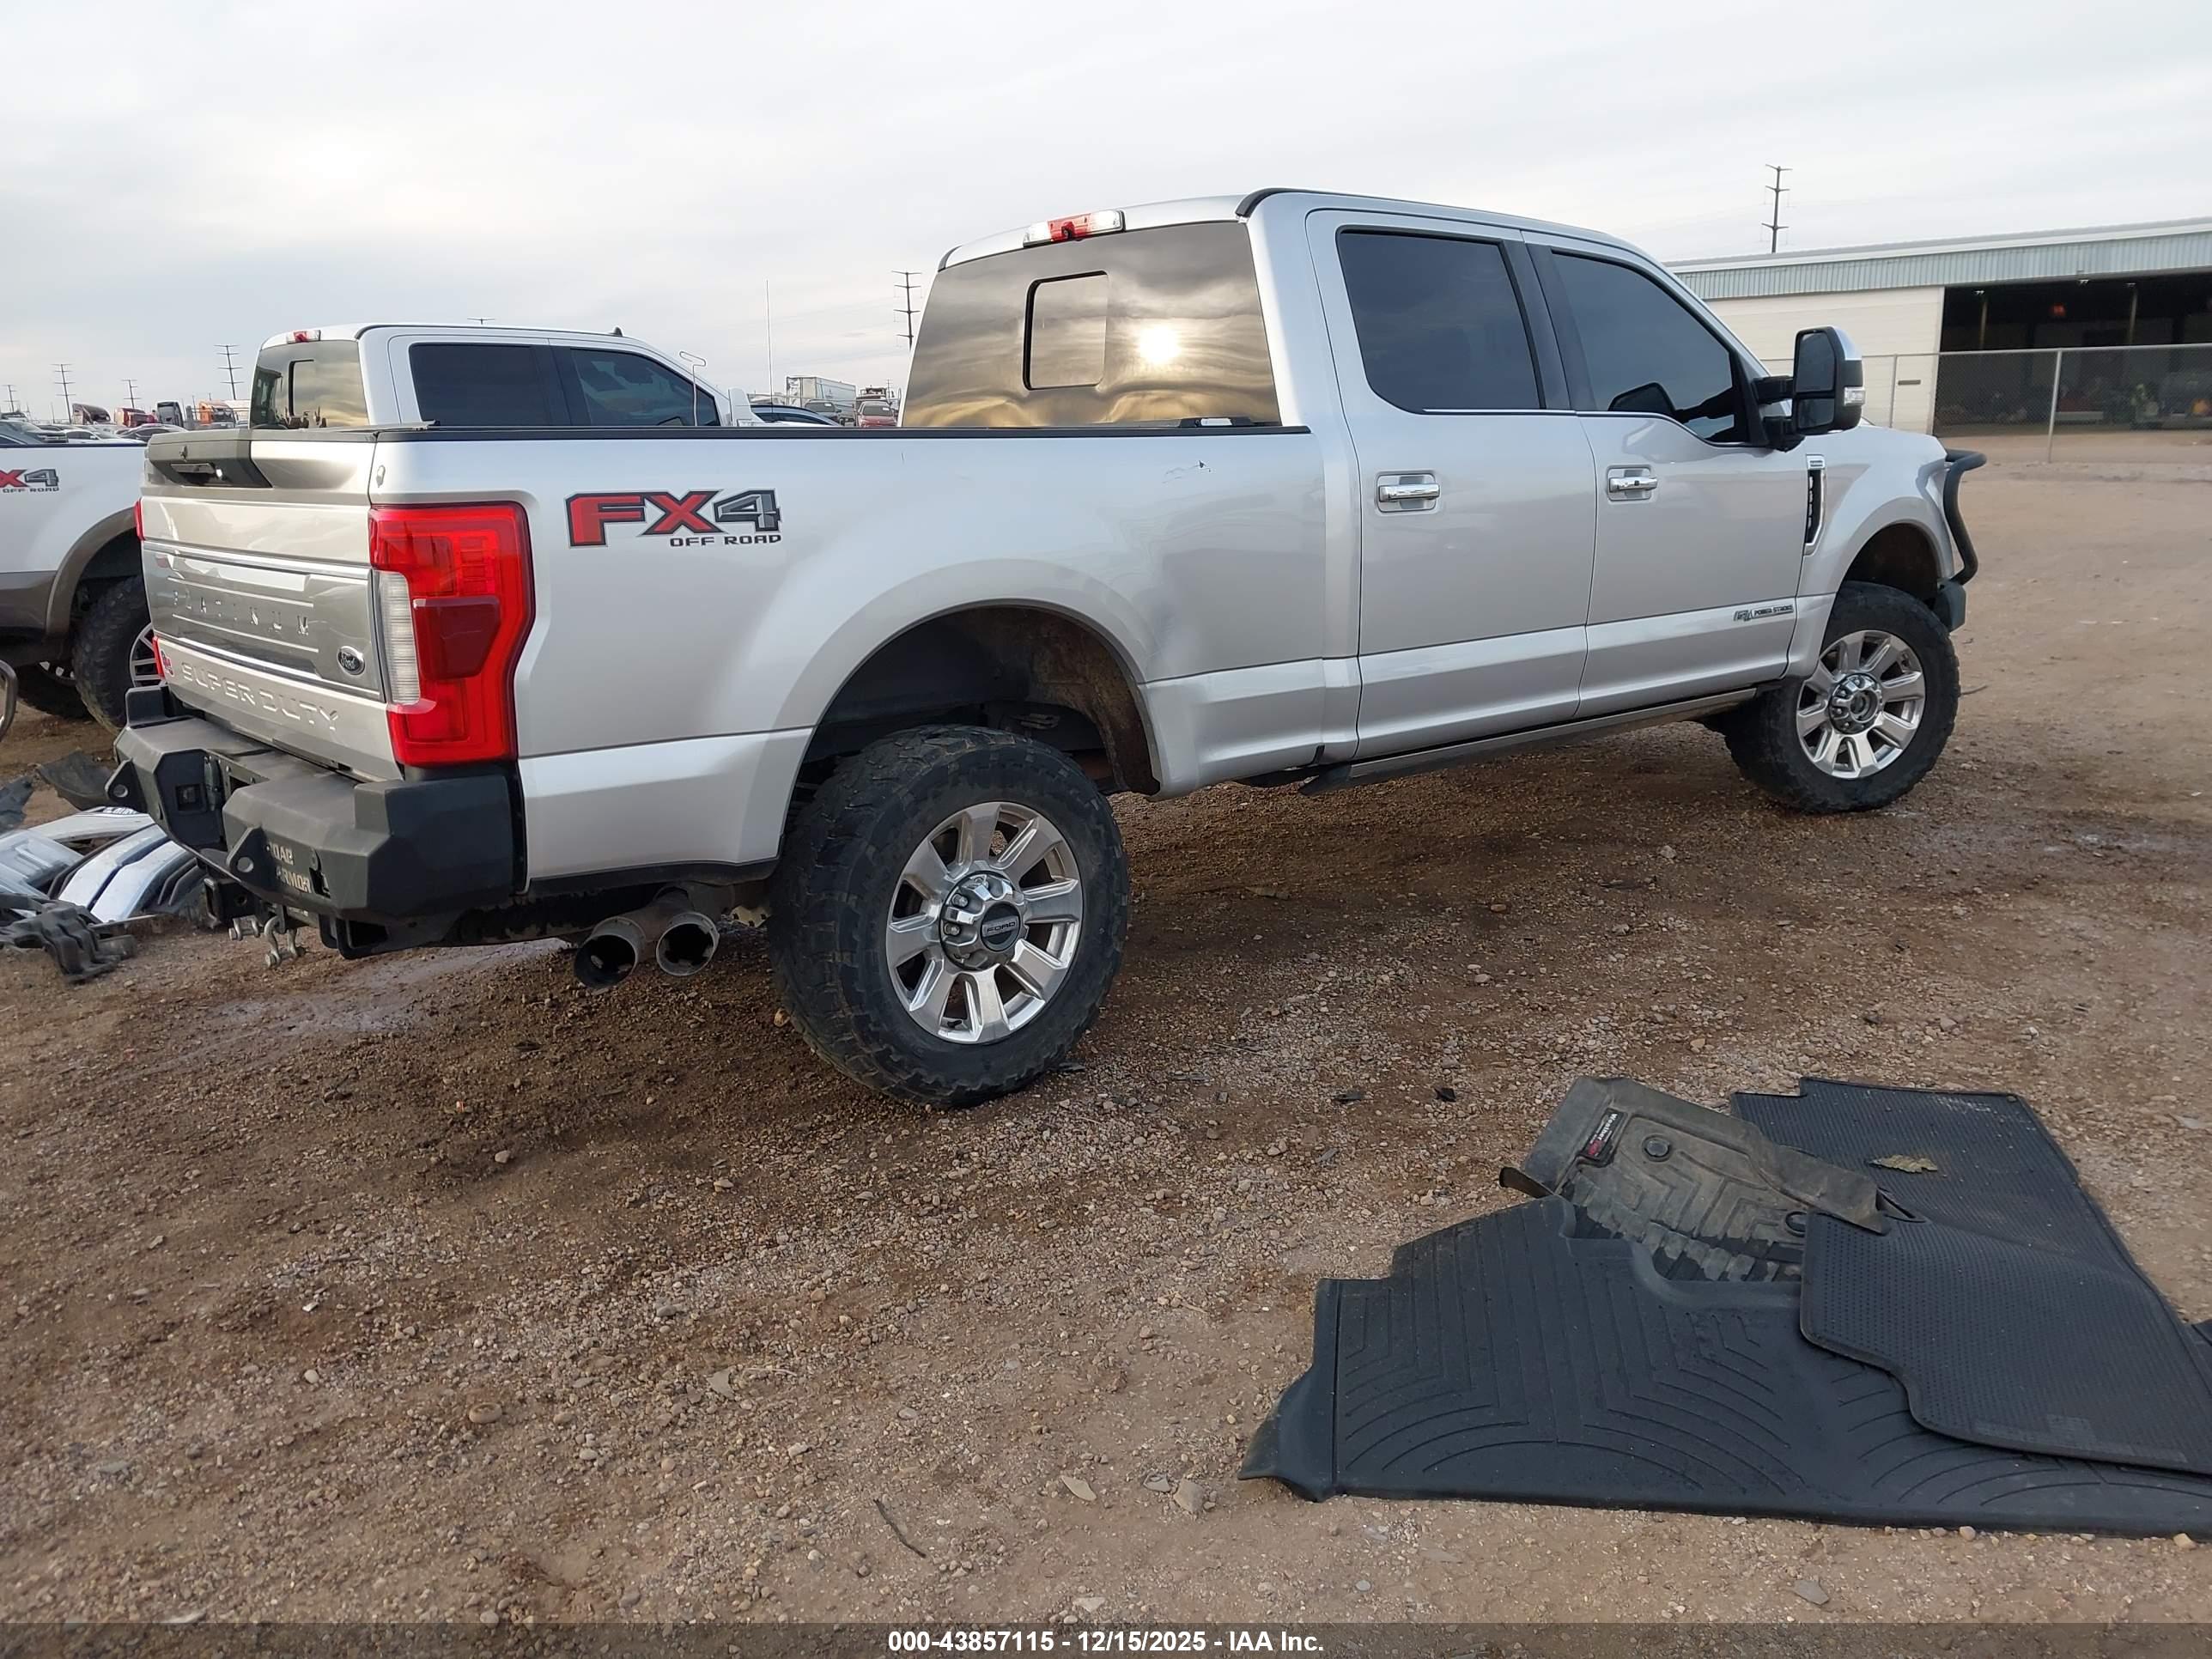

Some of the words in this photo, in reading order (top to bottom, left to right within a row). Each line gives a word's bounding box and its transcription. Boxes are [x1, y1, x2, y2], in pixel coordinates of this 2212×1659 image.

[0, 469, 59, 488] X4
[566, 489, 782, 547] FX4
[670, 535, 715, 547] OFF
[724, 533, 782, 545] ROAD
[181, 661, 256, 705] SUPER
[258, 688, 338, 731] DUTY
[987, 921, 1017, 933] FORD
